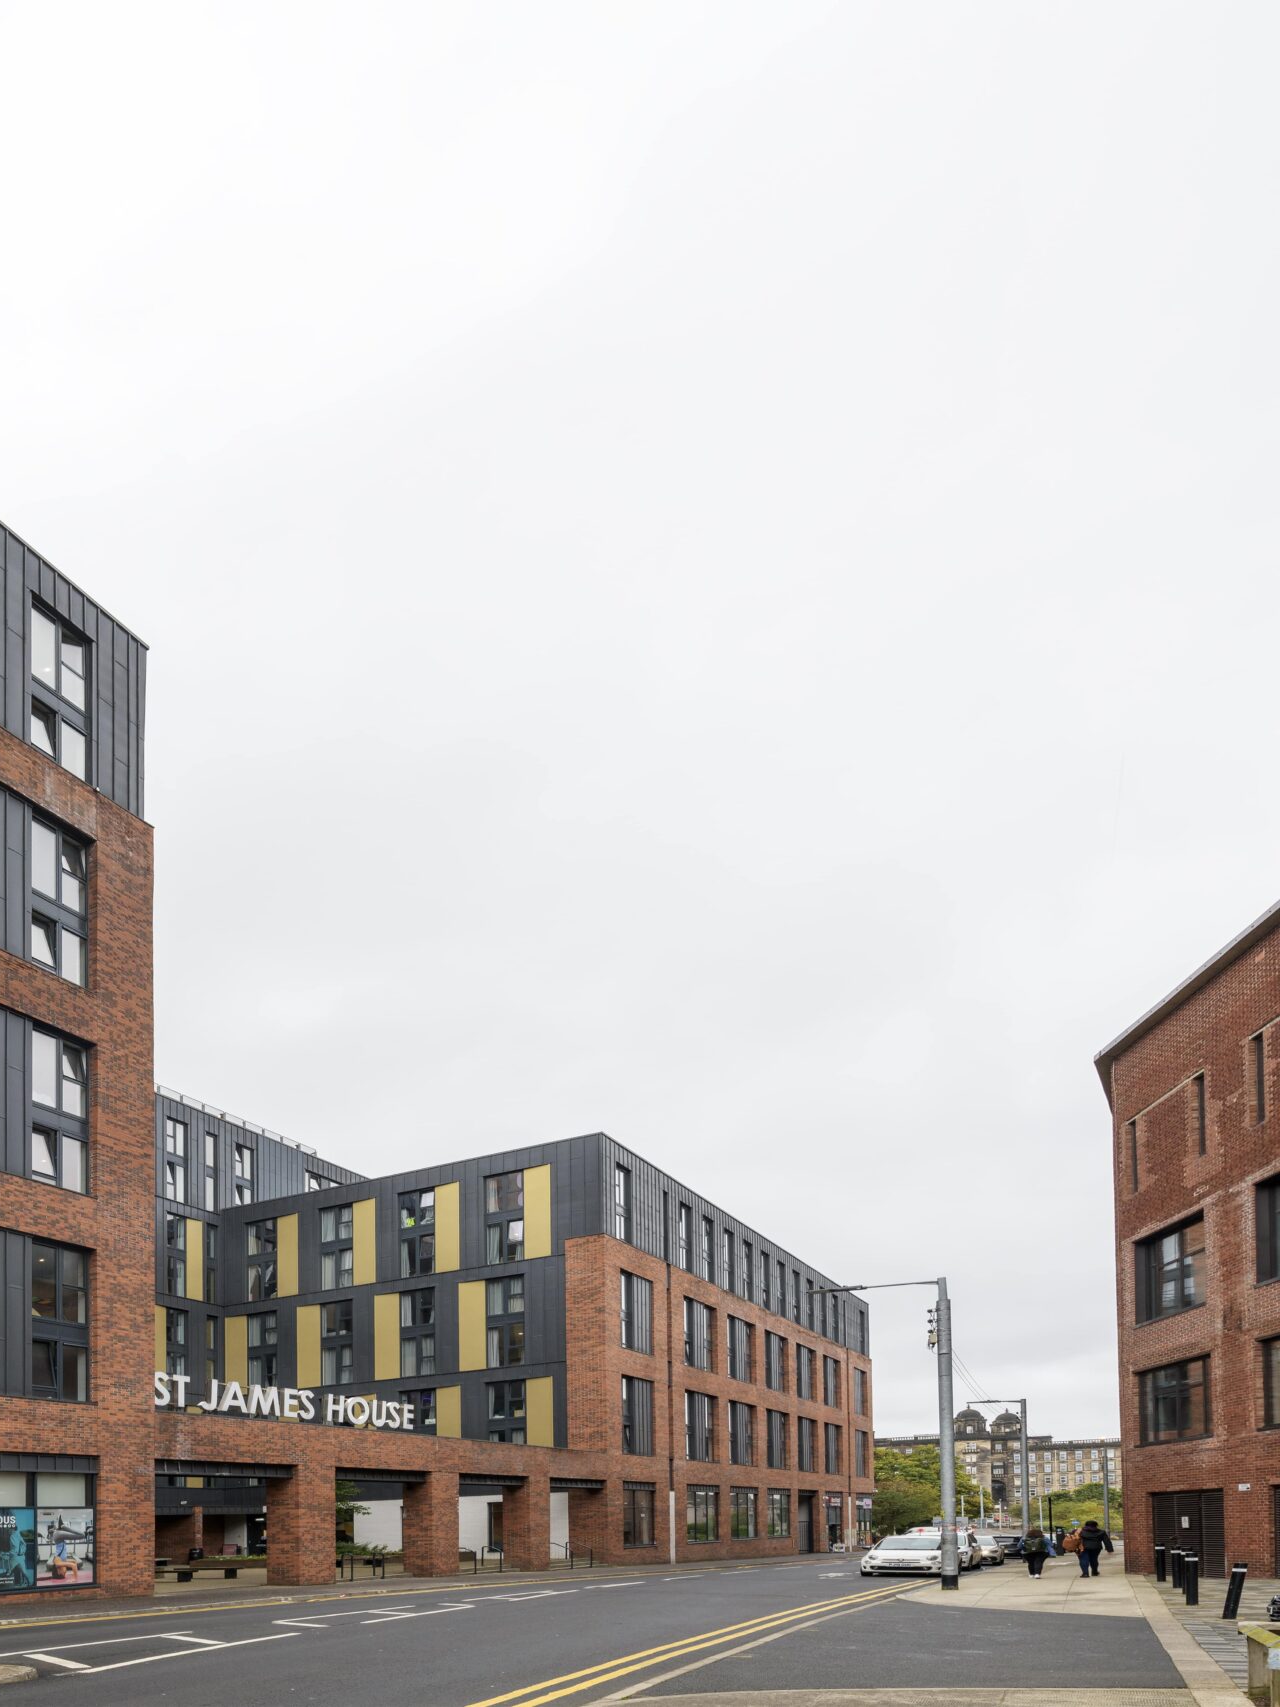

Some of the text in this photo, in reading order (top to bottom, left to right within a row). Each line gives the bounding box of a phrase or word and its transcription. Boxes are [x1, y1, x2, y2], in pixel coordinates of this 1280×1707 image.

[155, 1371, 415, 1430] ST JAMES HOUSE
